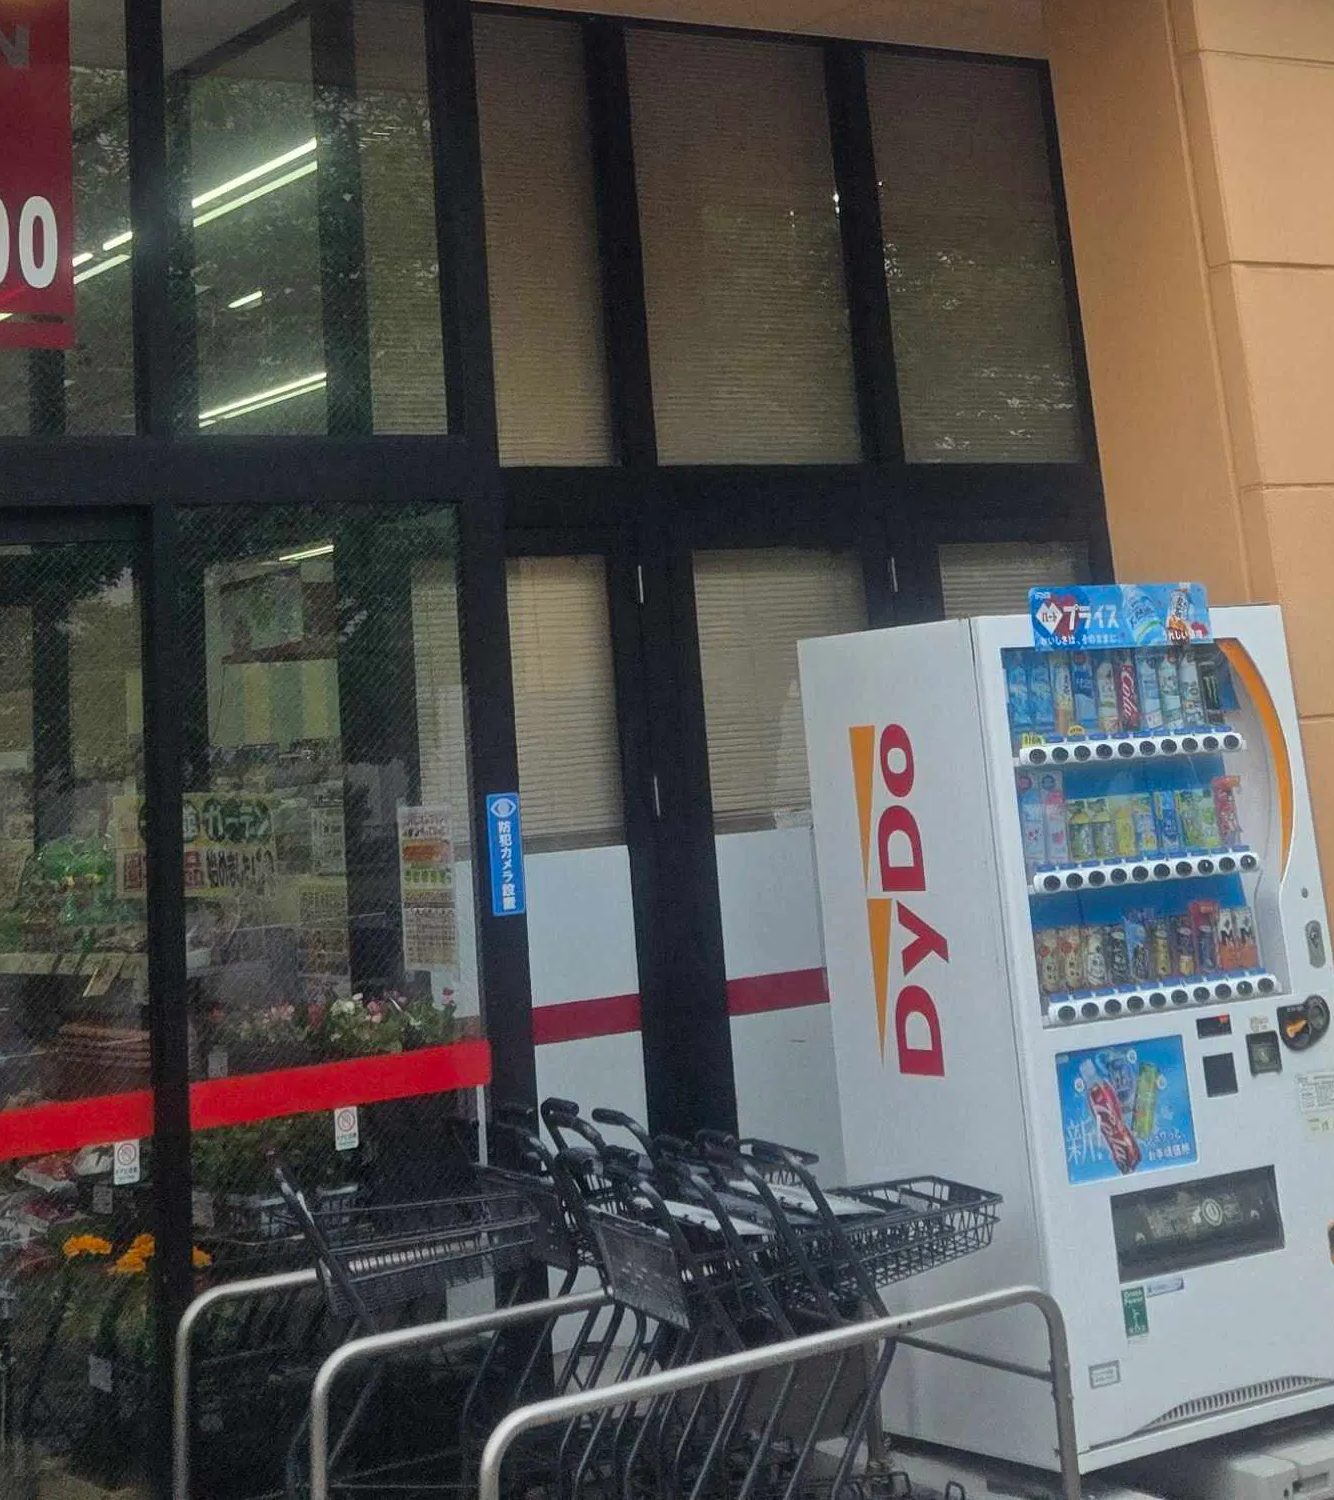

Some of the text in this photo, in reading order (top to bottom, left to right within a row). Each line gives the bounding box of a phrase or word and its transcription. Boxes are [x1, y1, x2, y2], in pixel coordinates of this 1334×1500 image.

[1063, 603, 1120, 631] プライス
[498, 820, 516, 911] 防犯カメラ設置
[878, 723, 950, 1077] DyDo
